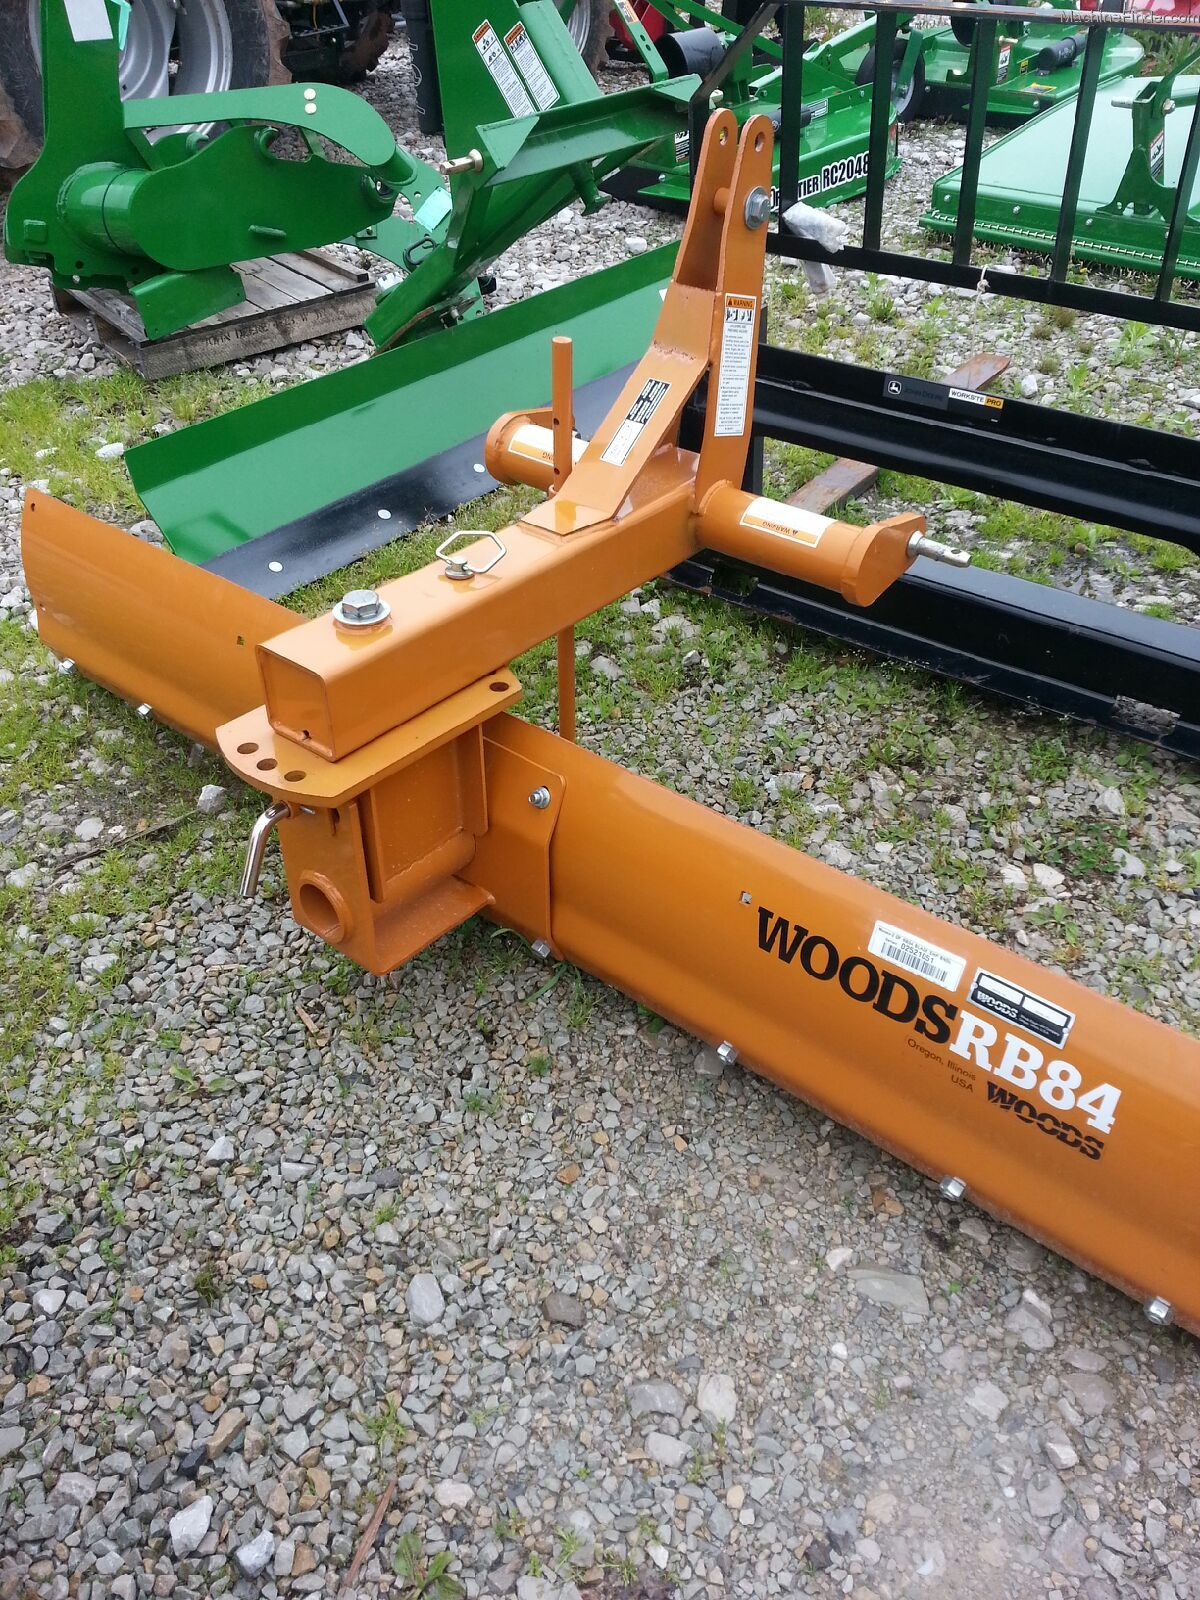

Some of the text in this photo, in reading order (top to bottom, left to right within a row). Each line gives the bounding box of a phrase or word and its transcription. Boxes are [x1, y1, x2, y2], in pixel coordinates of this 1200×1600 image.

[986, 397, 1002, 407] PRO
[762, 520, 791, 535] WARNING
[976, 990, 1019, 1019] WOODS
[758, 906, 1122, 1135] WOODS RB84
[907, 1037, 977, 1081] Oregon, Illinois
[951, 1075, 974, 1093] USA
[986, 1080, 1105, 1161] WOODS
